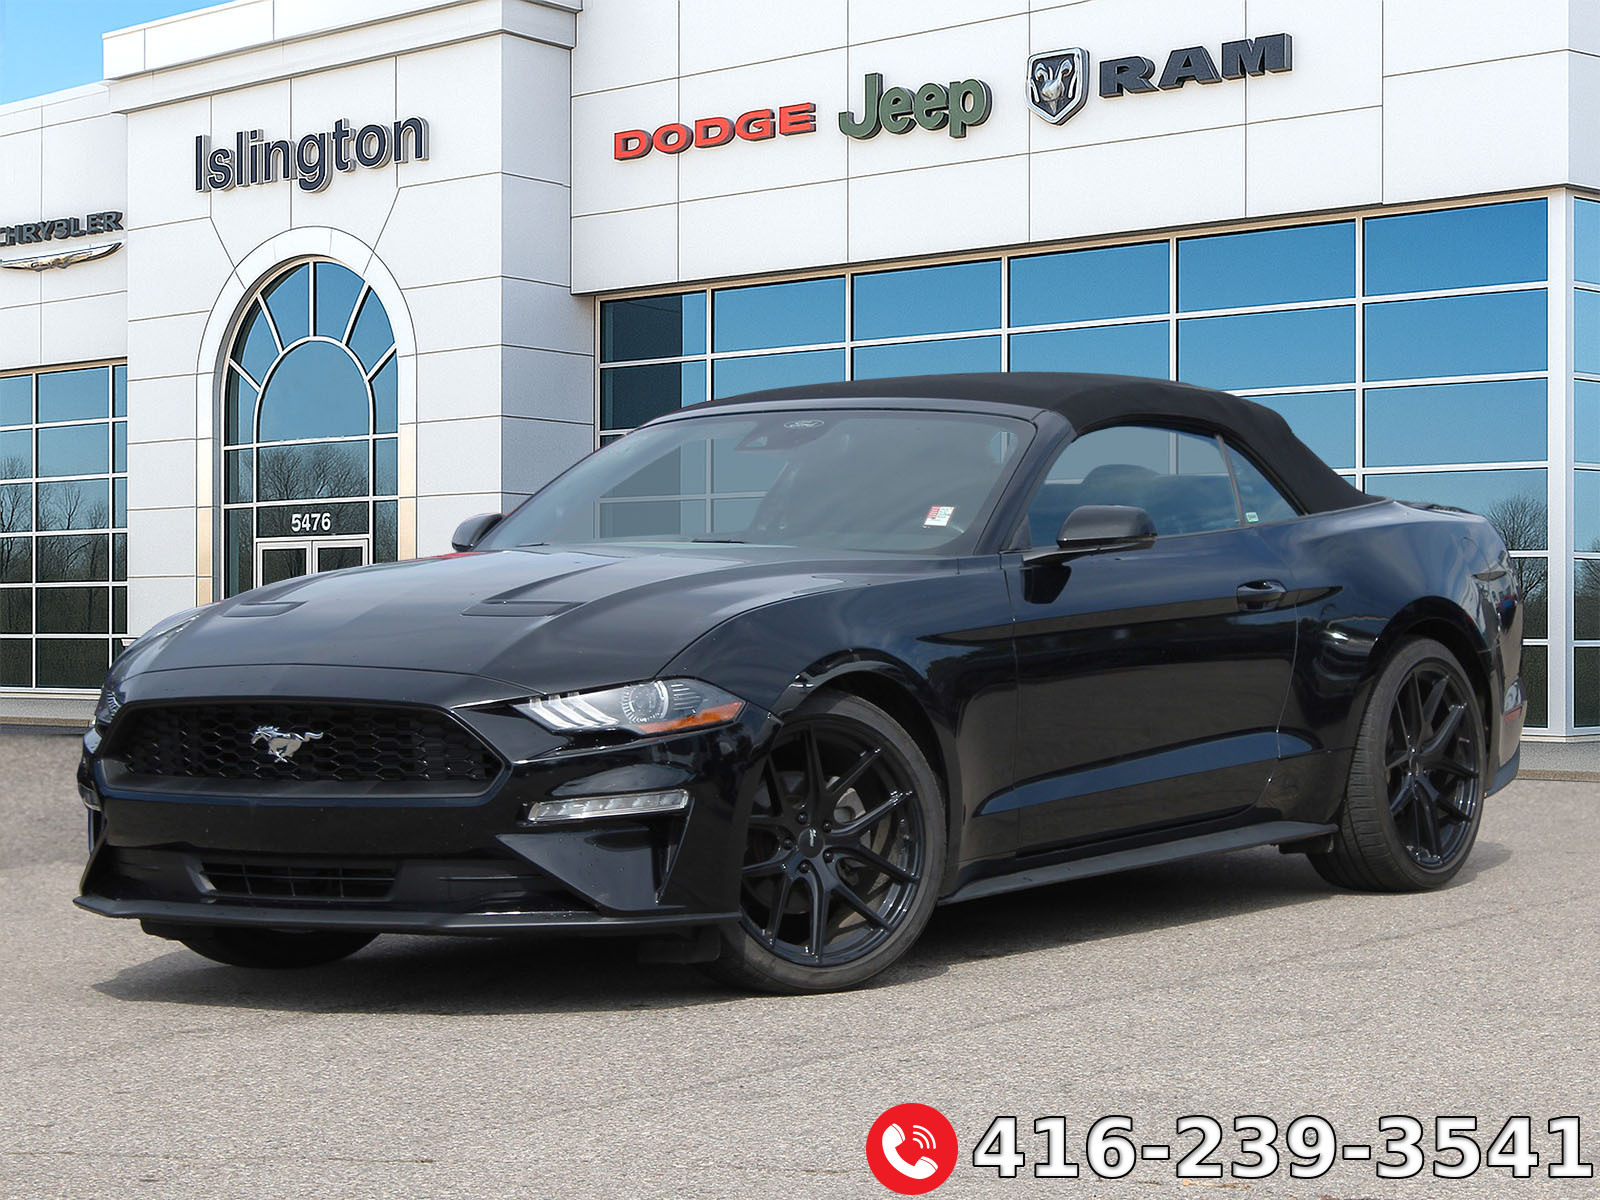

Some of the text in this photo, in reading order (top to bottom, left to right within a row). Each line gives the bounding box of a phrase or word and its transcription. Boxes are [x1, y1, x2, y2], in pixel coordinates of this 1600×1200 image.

[1100, 33, 1293, 98] RAM
[614, 102, 817, 161] DODGE
[838, 73, 992, 139] Jeep
[195, 116, 429, 193] Islington
[291, 512, 331, 532] 5476
